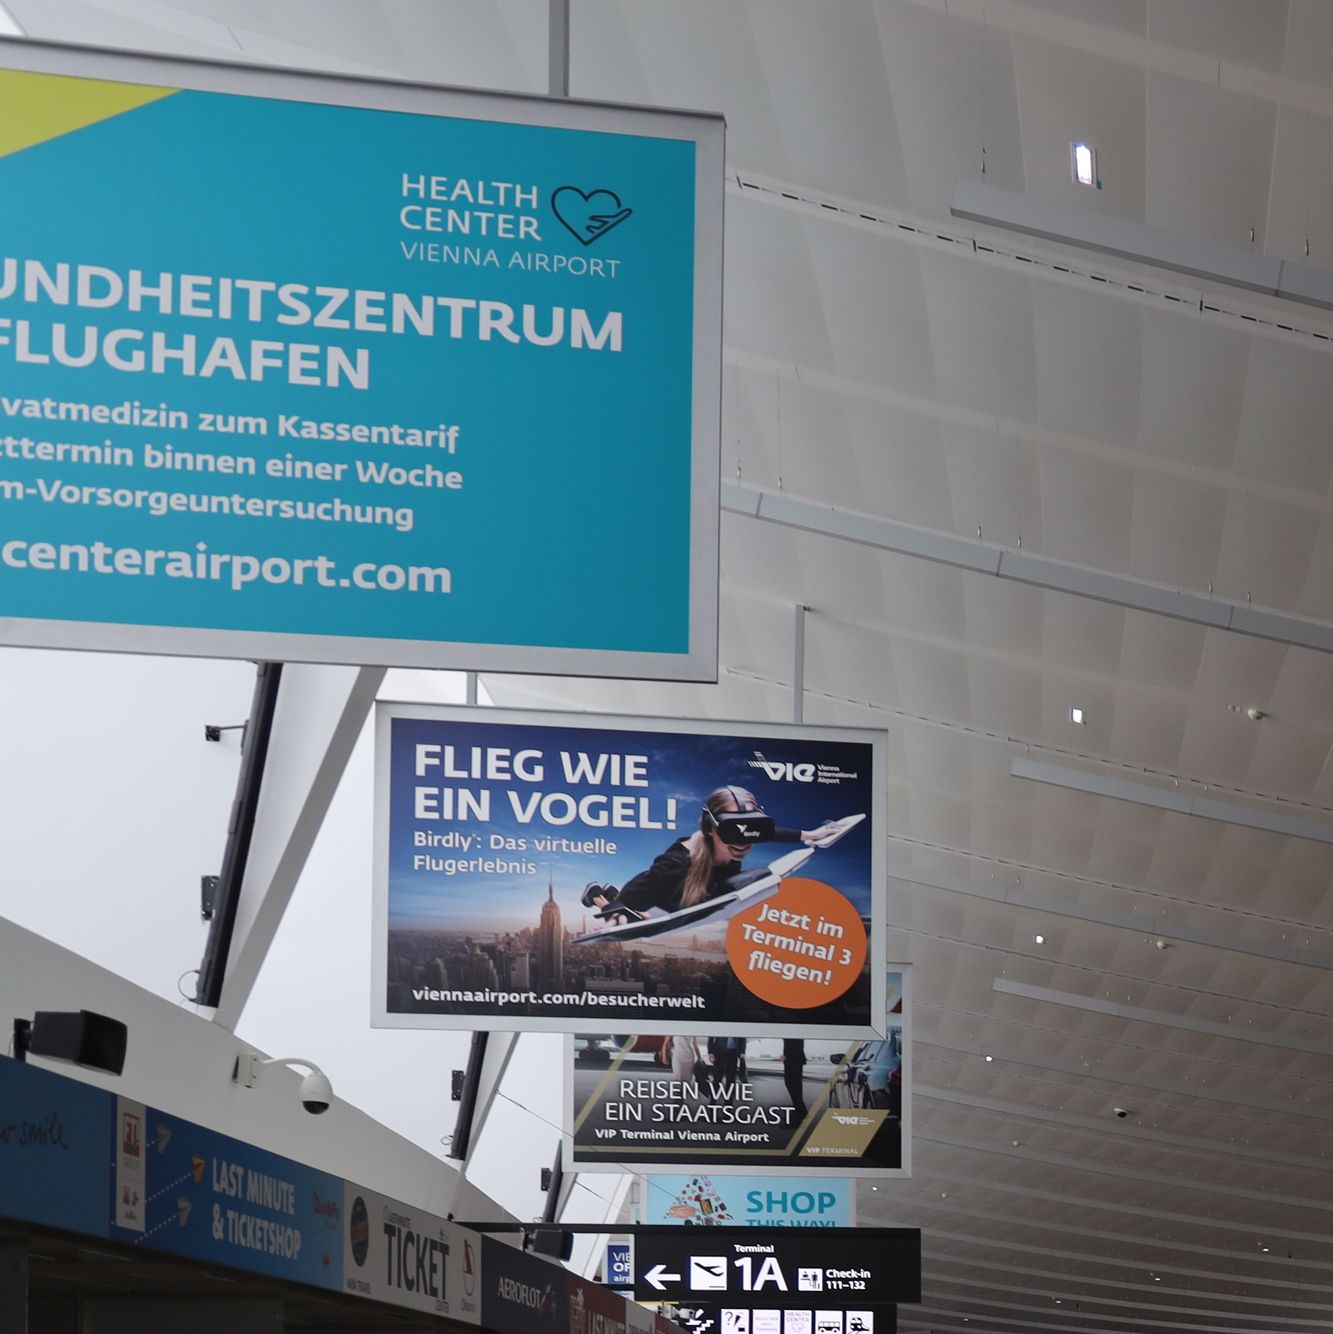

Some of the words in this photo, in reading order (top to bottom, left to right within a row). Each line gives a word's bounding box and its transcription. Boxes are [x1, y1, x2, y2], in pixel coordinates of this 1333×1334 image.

[401, 173, 538, 209] HEALTH
[400, 205, 541, 241] CENTER
[400, 241, 500, 267] VIENNA
[508, 249, 620, 278] AIRPORT
[0, 396, 188, 430] vatmedizin
[199, 411, 267, 434] zum
[278, 414, 460, 453] Kassentarif
[0, 436, 134, 467] ttermin
[144, 443, 256, 476] binnen
[265, 455, 346, 481] einer
[355, 459, 463, 490] Woche
[2, 539, 452, 594] centerairport.com
[415, 743, 543, 782] FLIEG
[561, 750, 649, 787] WIE
[414, 787, 490, 822] EIN
[507, 791, 677, 829] VOGEL!
[490, 835, 526, 851] Das
[534, 837, 617, 855] virtuelle
[413, 854, 537, 875] Flugerlebnis
[757, 904, 810, 931] Jetzt
[817, 917, 843, 939] im
[742, 923, 834, 961] Terminal
[839, 948, 851, 965] 3
[749, 950, 832, 985] fliegen!
[412, 987, 705, 1009] viennaairport.com/besucherwelt
[620, 1080, 699, 1100] REISEN
[710, 1083, 754, 1101] WIE
[605, 1103, 642, 1121] EIN
[652, 1105, 795, 1125] STAATSGAST
[595, 1129, 617, 1138] VIP
[621, 1129, 674, 1140] Terminal
[678, 1131, 721, 1141] Vienna
[725, 1131, 769, 1143] Airport
[212, 1157, 243, 1199] LAST
[247, 1170, 295, 1216] MINUTE
[746, 1190, 836, 1214] SHOP
[212, 1203, 224, 1239] &
[227, 1210, 300, 1260] TICKETSHOP
[734, 1244, 774, 1253] Terminal
[384, 1222, 449, 1300] TICKET
[733, 1257, 788, 1291] 1A
[826, 1269, 871, 1279] Check-in
[498, 1276, 540, 1310] AEROFLOT
